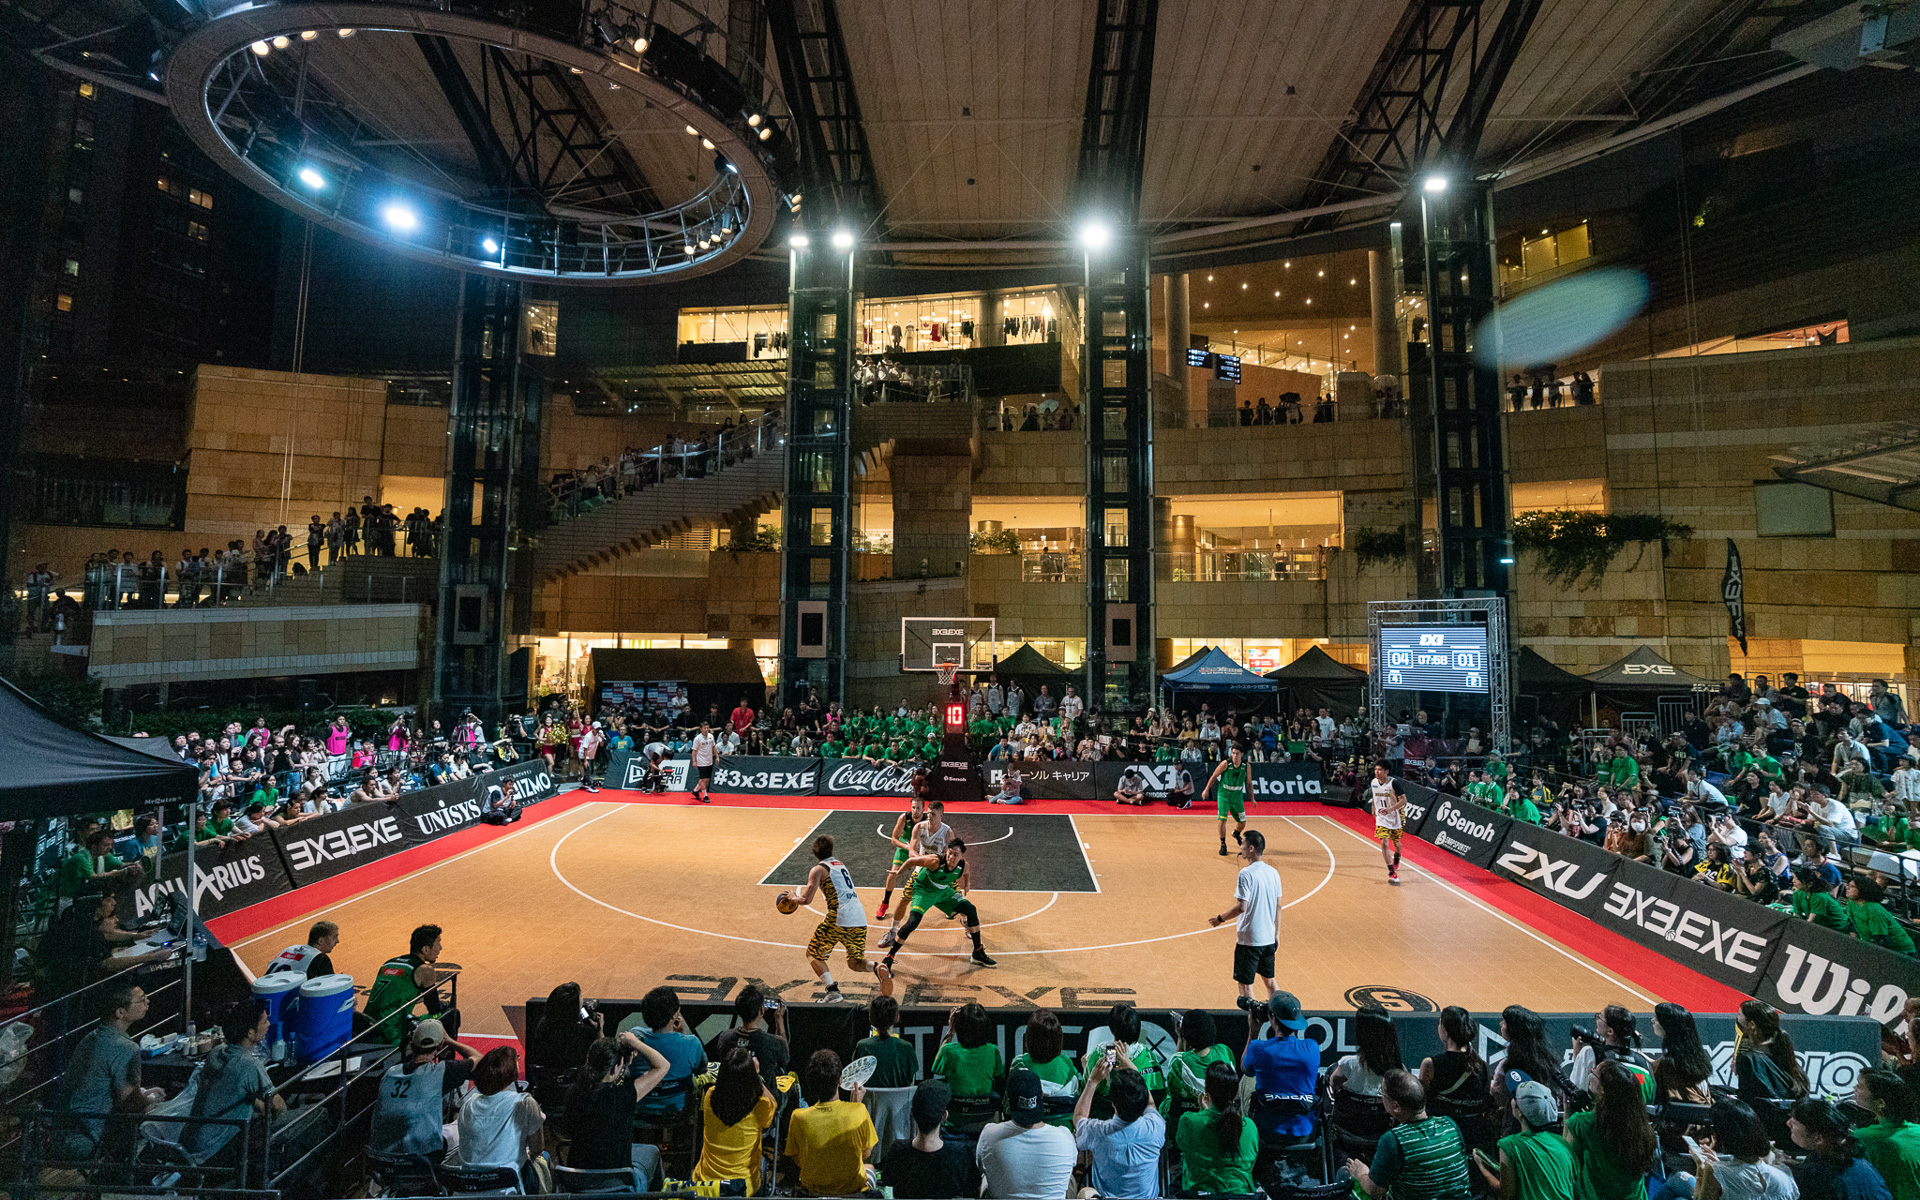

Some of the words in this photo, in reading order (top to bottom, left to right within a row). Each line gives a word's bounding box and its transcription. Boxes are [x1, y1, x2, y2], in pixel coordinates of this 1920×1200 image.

[1391, 652, 1410, 665] 04
[1418, 654, 1448, 666] 07:58
[1457, 653, 1476, 667] 01
[947, 705, 963, 725] 10
[1052, 771, 1090, 781] キャリア
[1447, 808, 1496, 842] Senoh
[840, 868, 853, 889] 6
[1496, 841, 1608, 900] 2XU
[369, 980, 391, 1002] 7
[390, 1080, 412, 1099] 32
